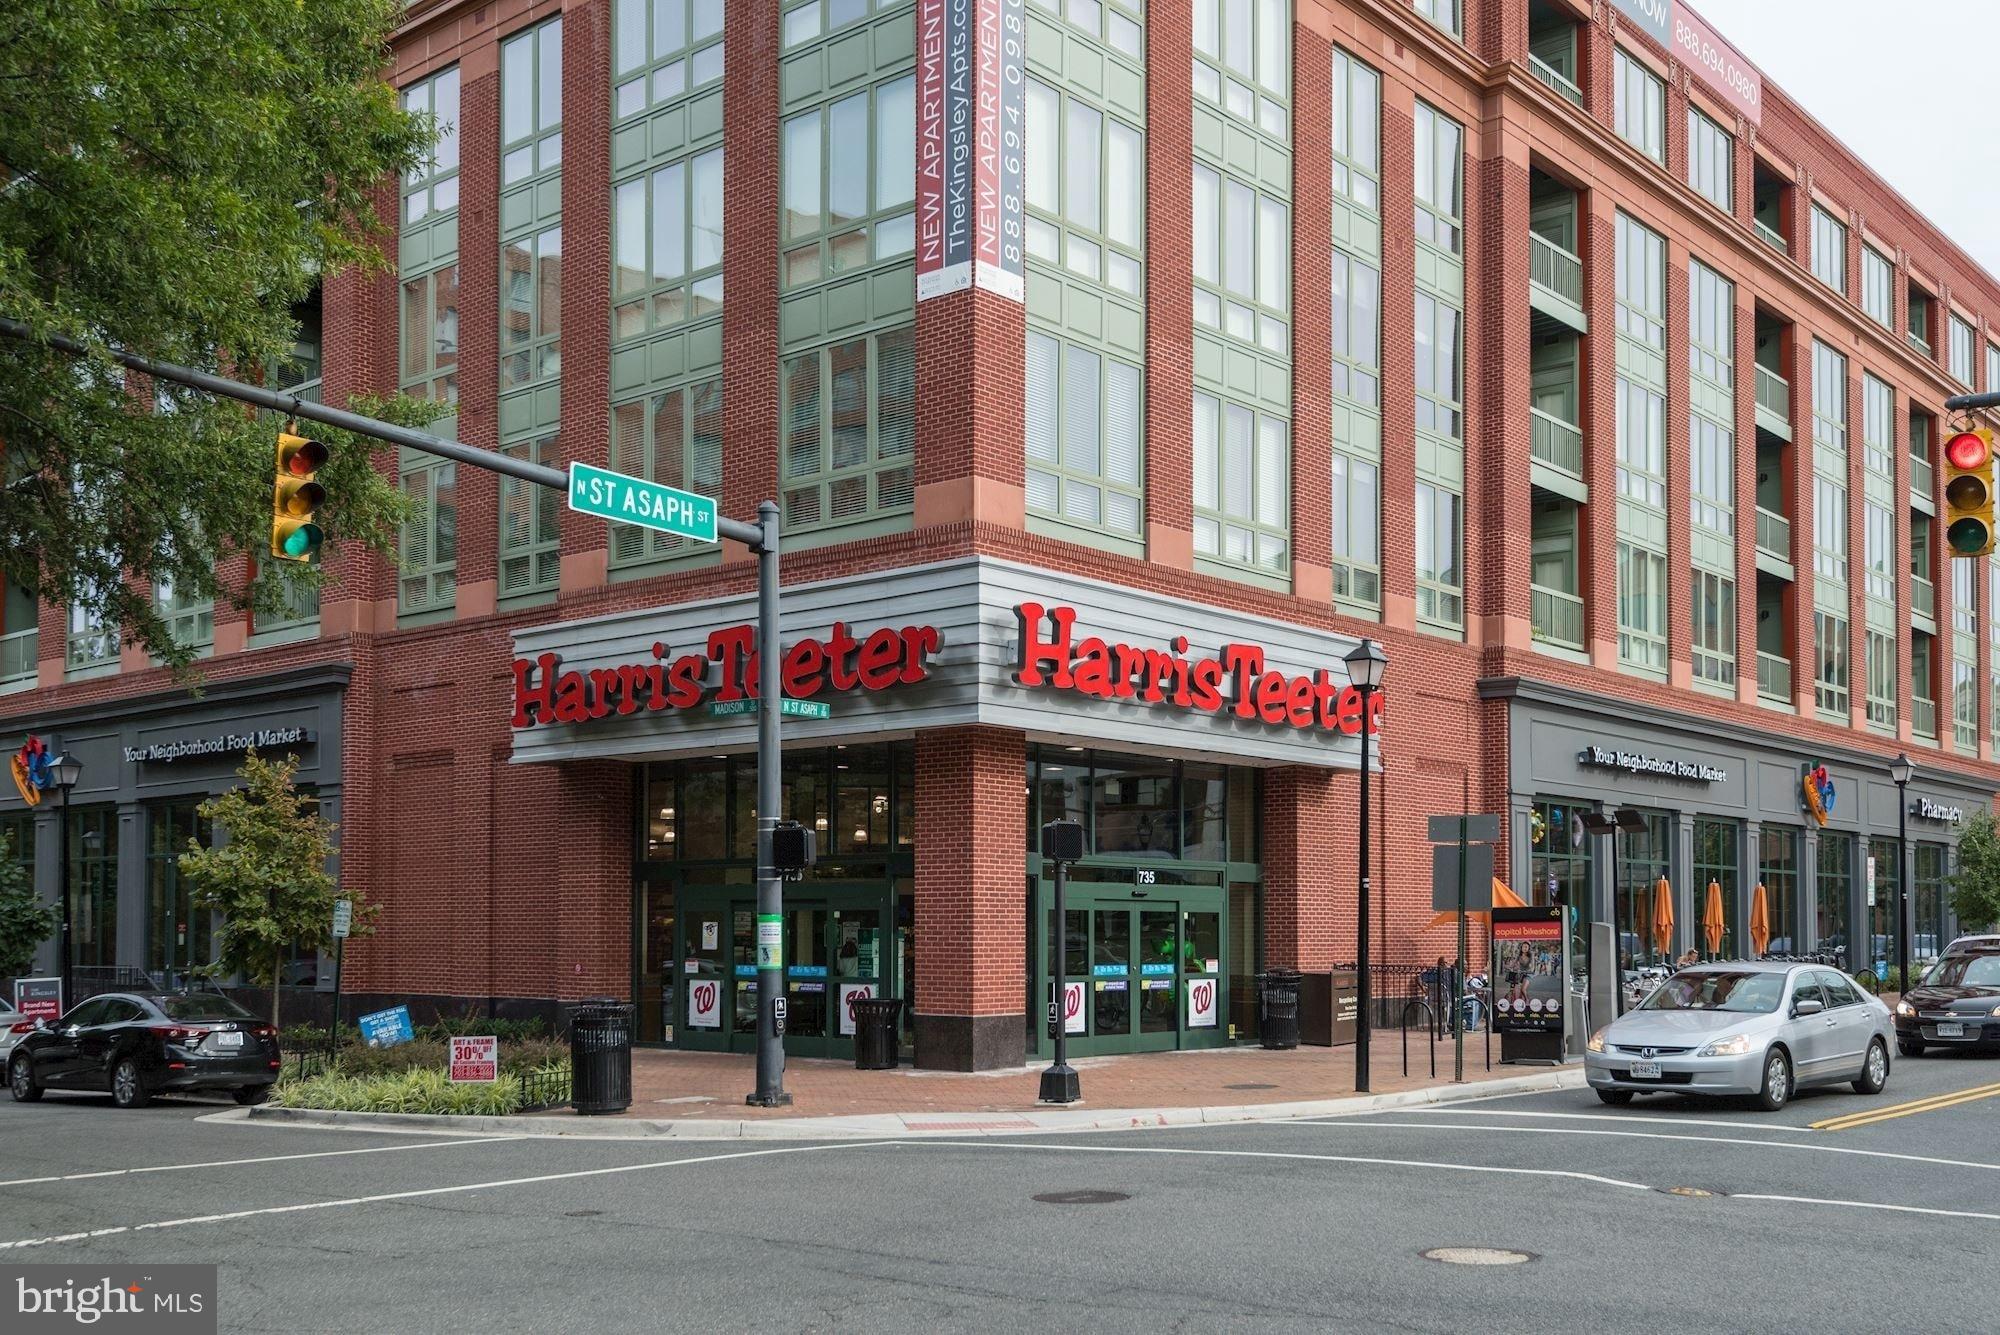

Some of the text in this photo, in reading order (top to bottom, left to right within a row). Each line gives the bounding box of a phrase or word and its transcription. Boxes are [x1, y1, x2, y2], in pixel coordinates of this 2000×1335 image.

[1676, 20, 1757, 105] 888.694.0980
[923, 192, 940, 263] NEW
[980, 181, 997, 255] NEW
[576, 477, 710, 528] N ST ASAPH ST
[511, 641, 706, 728] Harris
[1013, 602, 1384, 735] Harris Teeter
[714, 701, 745, 715] MADISON
[783, 701, 818, 715] N ST ASAPH
[123, 727, 302, 763] Your Neighborhood Food Market
[1592, 745, 1727, 782] Your Neighborhood Food Market
[1921, 797, 1963, 823] Pharmacy
[1138, 870, 1155, 884] 735
[1495, 927, 1559, 937] capital bikeshare
[23, 1008, 57, 1016] Apartments
[694, 982, 716, 1014] W
[1192, 981, 1212, 1014] W
[455, 1046, 483, 1060] 30%
